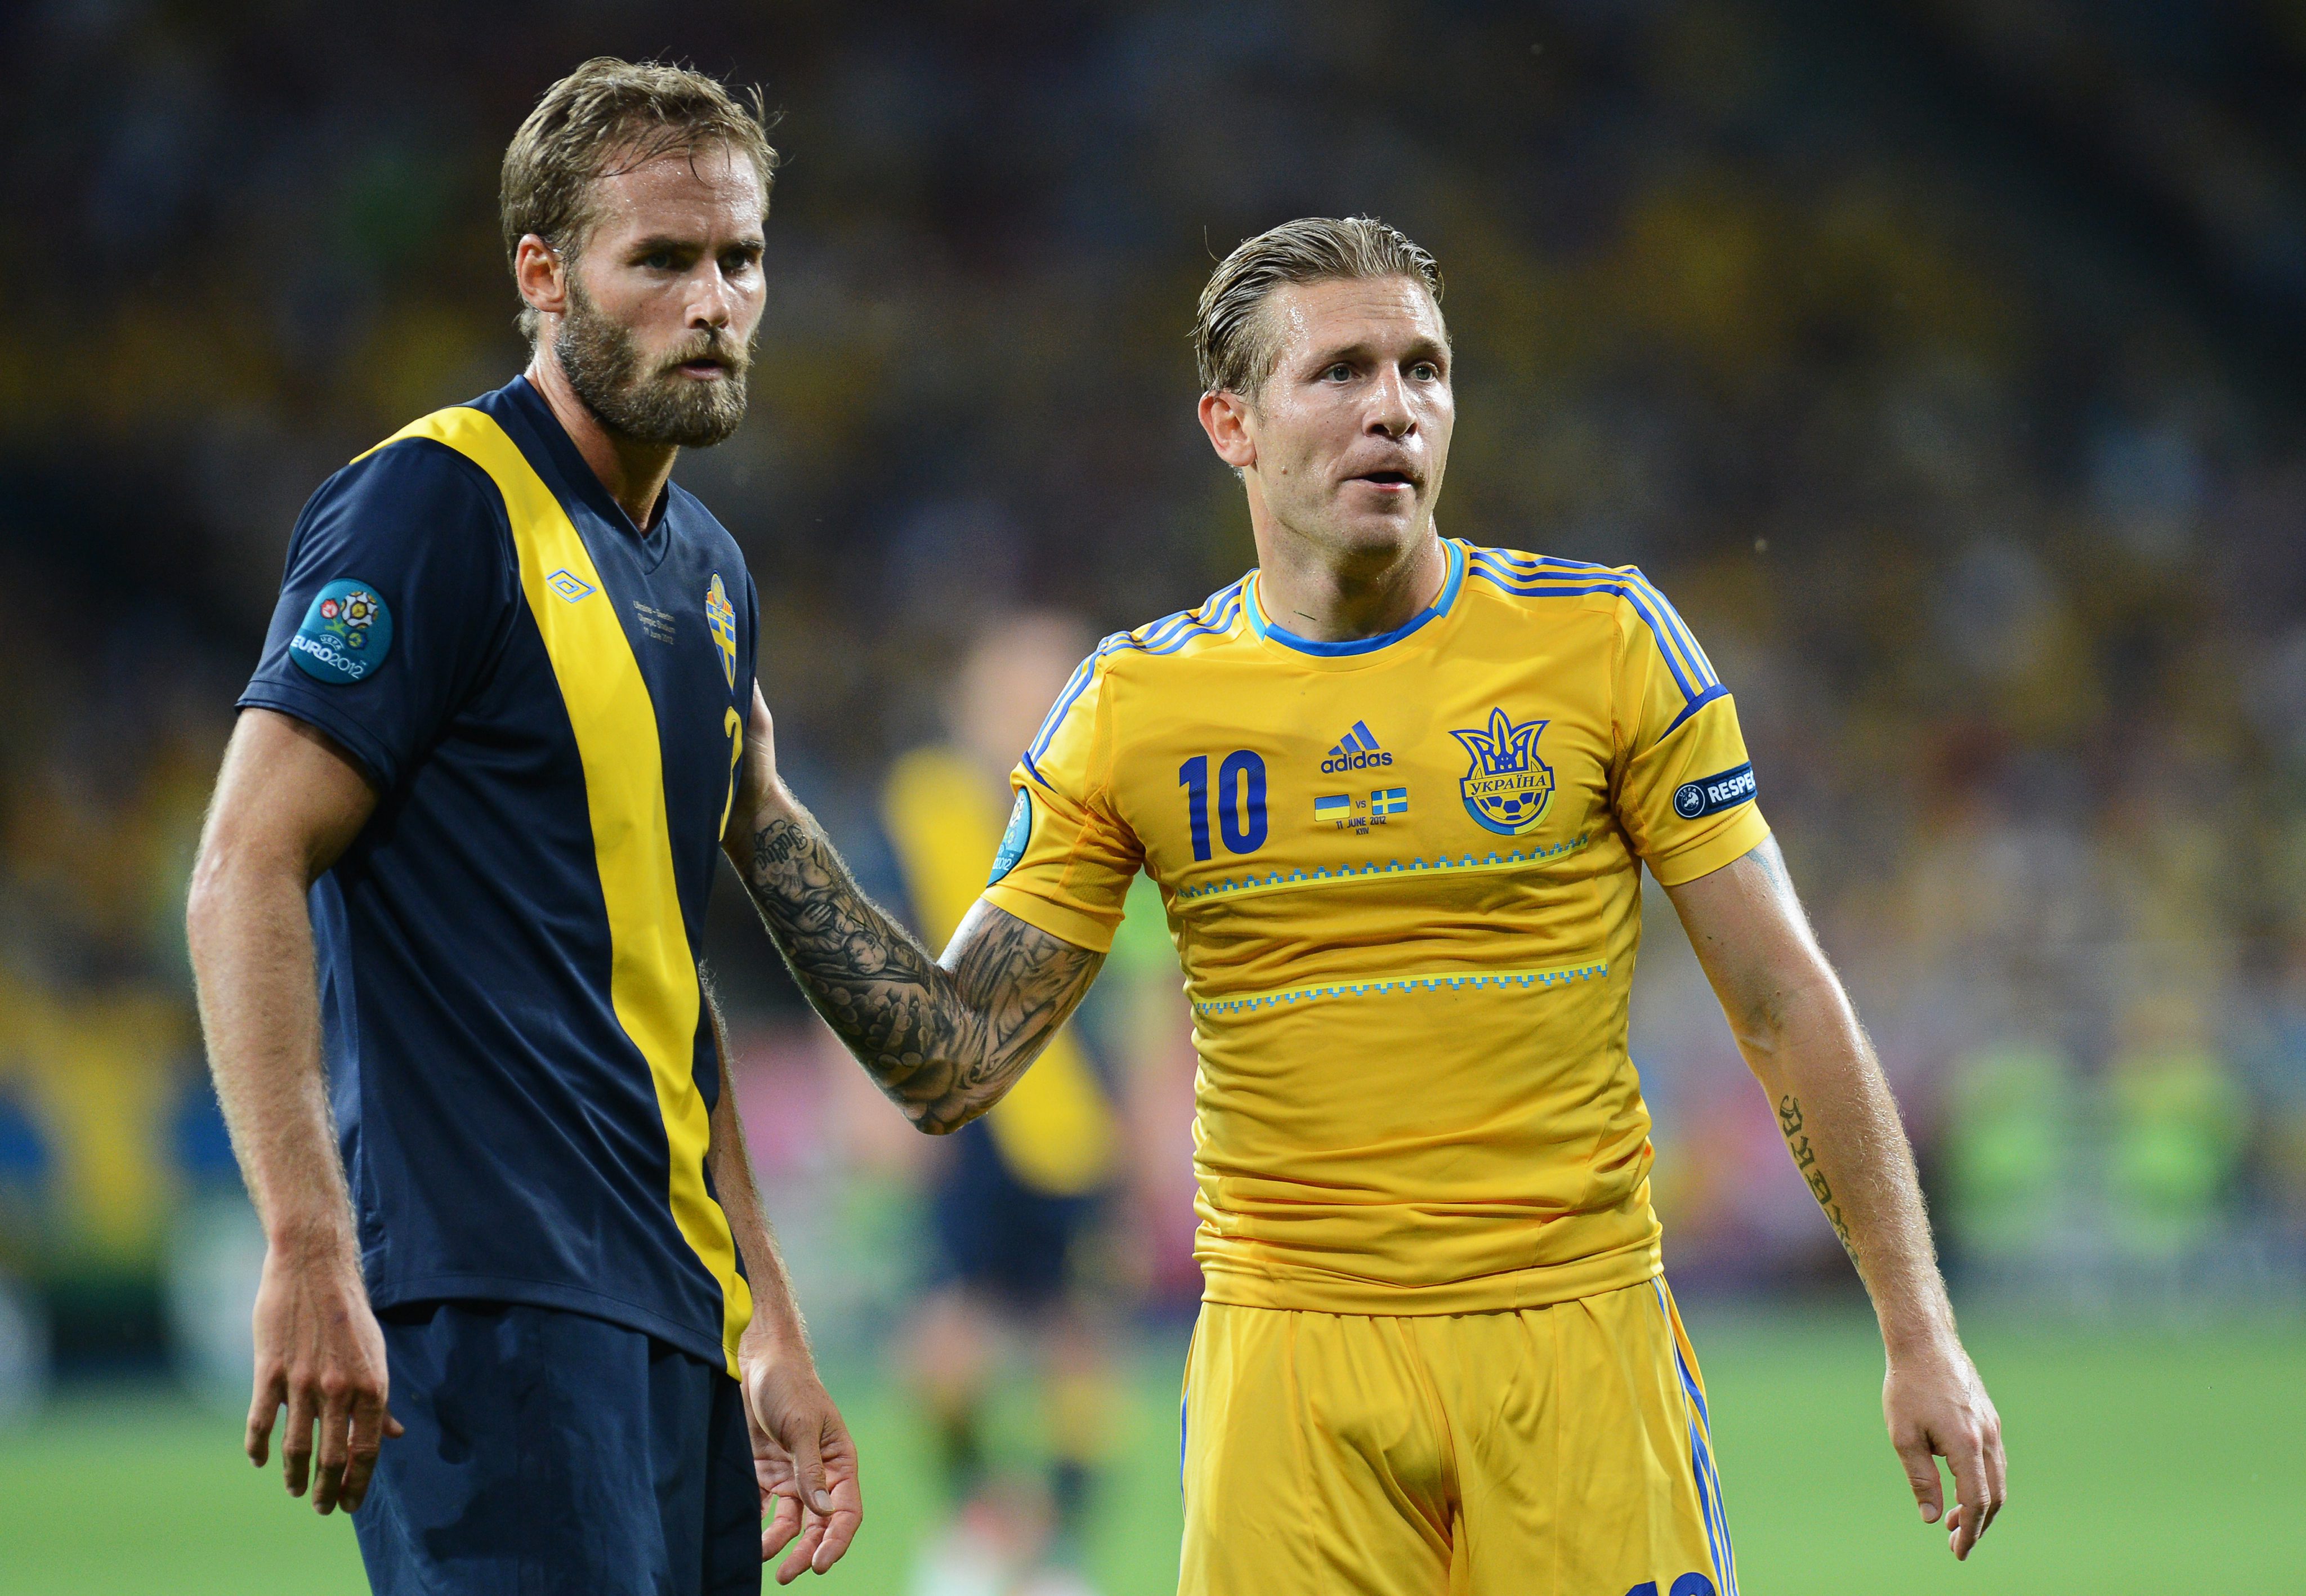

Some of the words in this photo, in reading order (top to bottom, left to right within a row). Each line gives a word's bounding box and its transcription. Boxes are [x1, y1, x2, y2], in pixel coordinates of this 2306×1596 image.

[1320, 751, 1393, 774] adidas
[1469, 774, 1547, 796] УКРАЇНА
[1679, 787, 1697, 798] UEFA
[1178, 749, 1268, 861] 10
[1336, 820, 1343, 830] 11
[1347, 817, 1366, 829] JUNE
[1370, 816, 1387, 826] 2012
